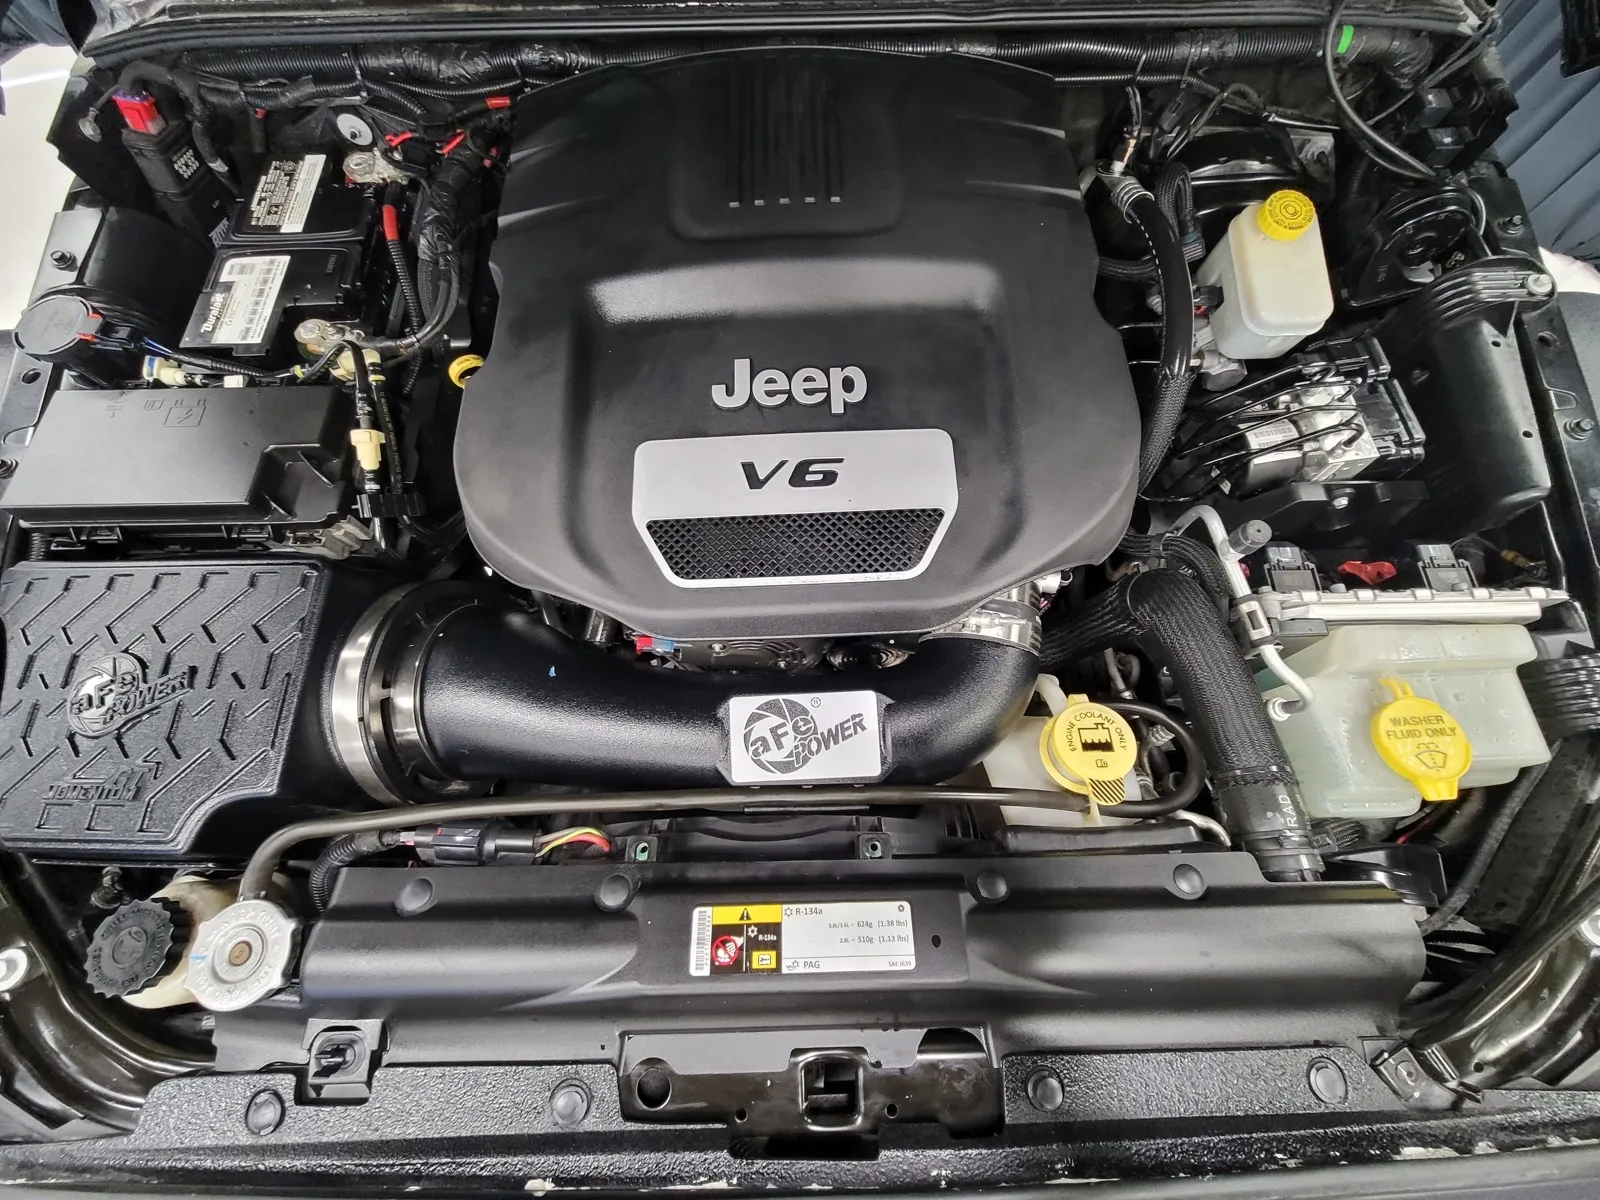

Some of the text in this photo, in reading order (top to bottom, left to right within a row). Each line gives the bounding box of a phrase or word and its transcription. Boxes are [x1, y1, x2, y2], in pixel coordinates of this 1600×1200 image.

[200, 292, 225, 333] Duralast
[711, 358, 868, 414] Jeep
[740, 457, 845, 490] V6
[749, 716, 815, 759] aFe
[1066, 711, 1127, 752] ENGINE COOLANT ONLY
[1386, 727, 1457, 740] FLUID ONLY
[1389, 715, 1445, 727] WASHER
[793, 712, 868, 768] POWER
[1278, 794, 1299, 828] RAD
[795, 906, 823, 916] R-134a
[857, 920, 873, 929] 624g
[877, 919, 895, 929] (1.38
[895, 919, 908, 928] lbs)
[857, 935, 874, 944] 510g
[878, 935, 896, 944] (1.13
[896, 935, 909, 944] lbs)
[803, 960, 820, 969] PAG
